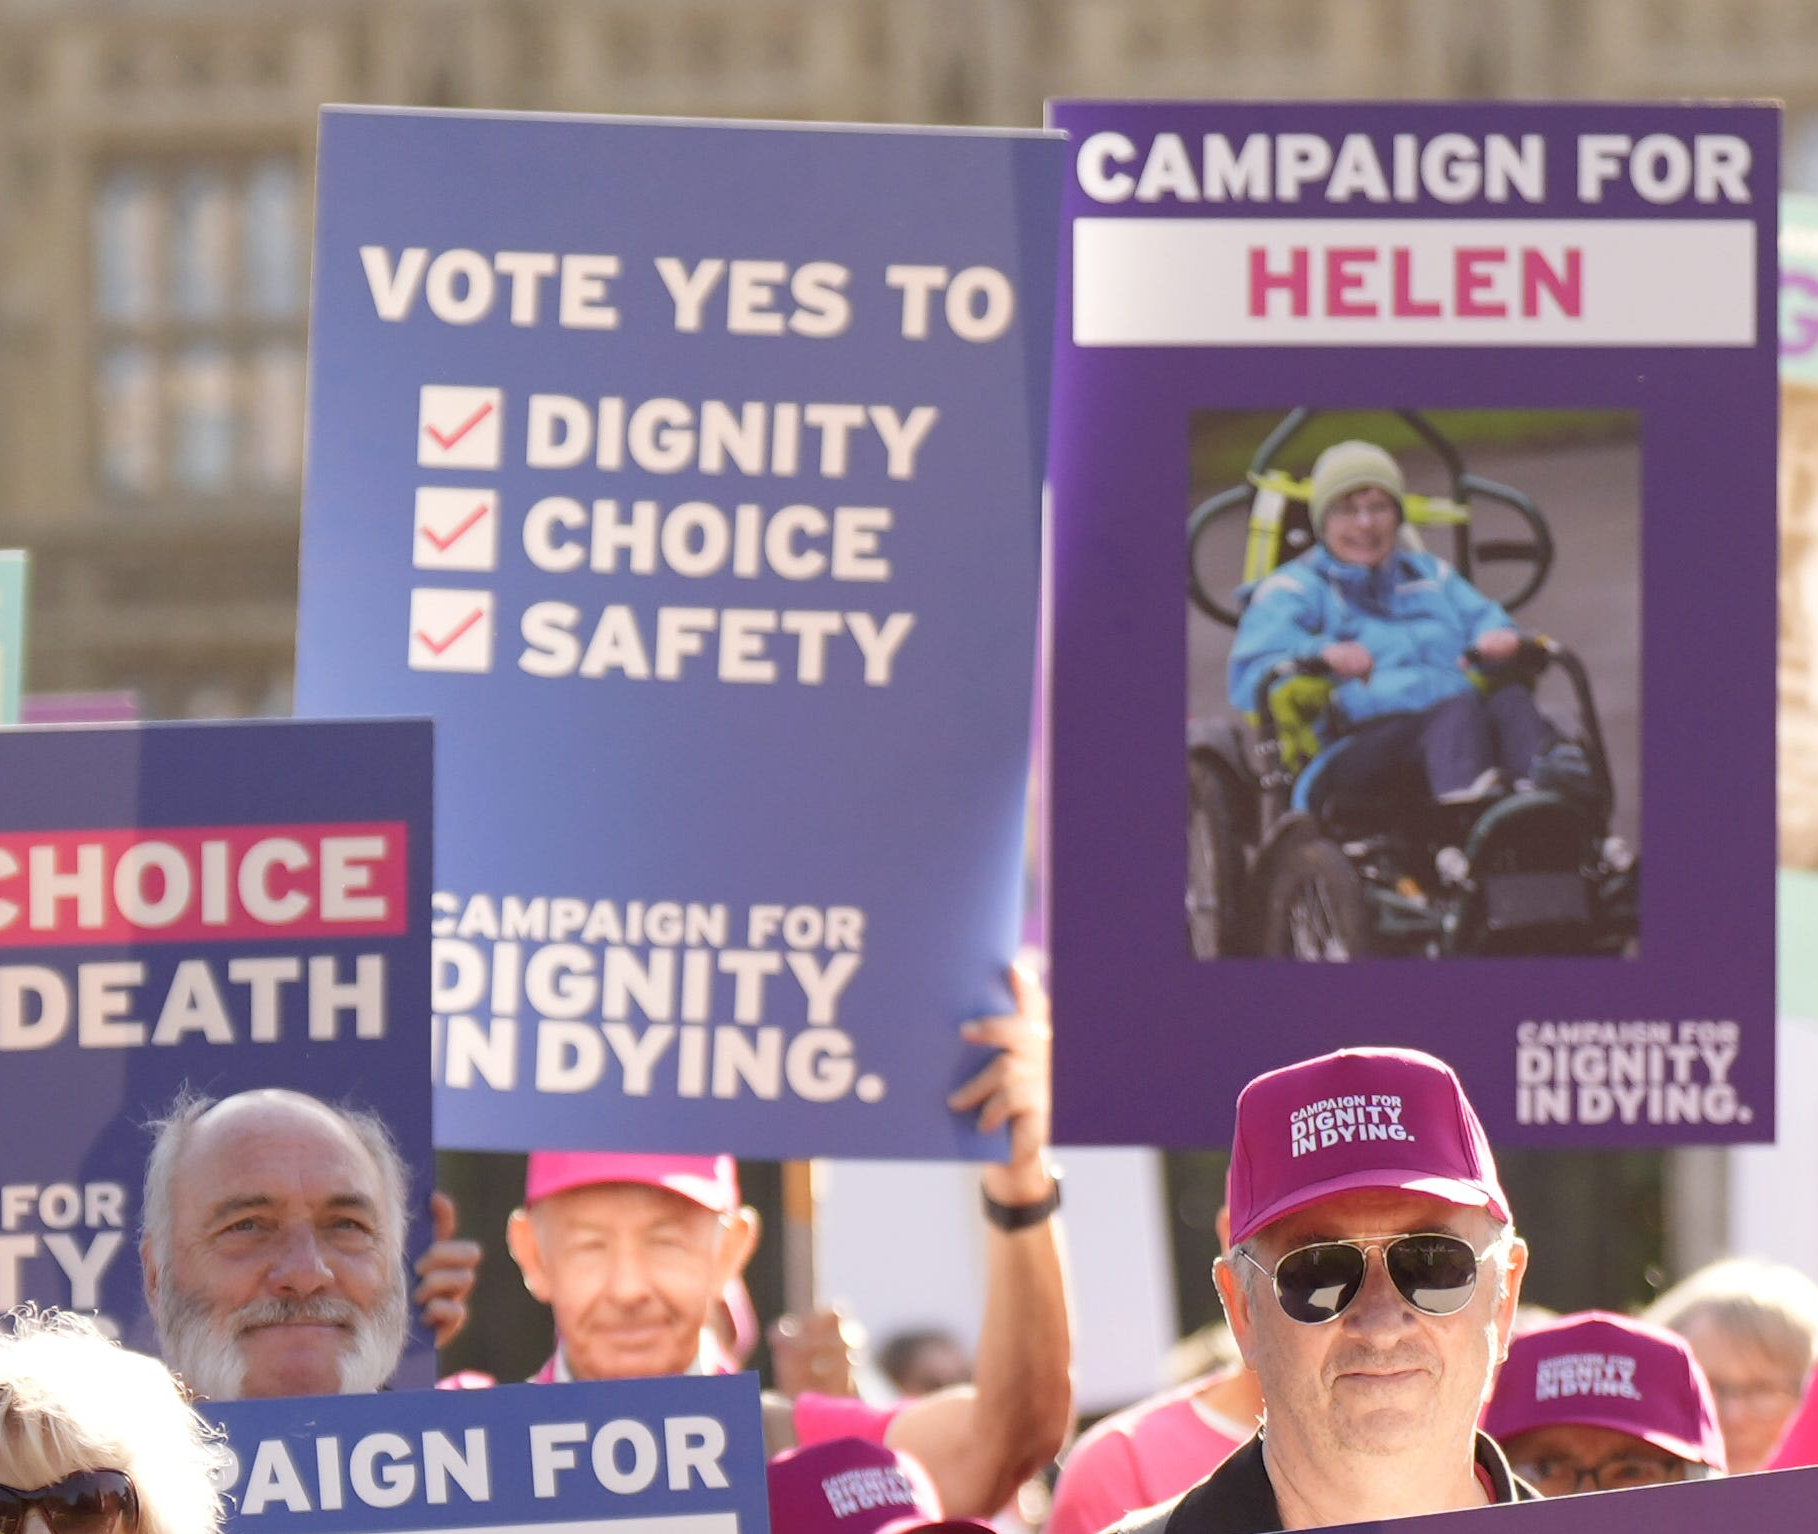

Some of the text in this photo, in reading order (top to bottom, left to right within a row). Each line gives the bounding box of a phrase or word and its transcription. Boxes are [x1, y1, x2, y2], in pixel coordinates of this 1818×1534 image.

[1076, 131, 1751, 203] CAMPAIGN FOR
[360, 245, 1014, 341] VOTE YES TO
[1246, 246, 1583, 318] HELEN
[526, 394, 938, 480] DIGNITY
[522, 497, 892, 581] CHOICE
[517, 601, 913, 686] SAFETY
[431, 892, 865, 950] CAMPAIGN FOR
[433, 942, 862, 1025] DIGNITY
[536, 1022, 887, 1103] DYING.
[1516, 1044, 1740, 1085] DIGNITY
[1291, 1106, 1402, 1141] DIGNITY
[1371, 1095, 1402, 1107] FOR
[1516, 1083, 1754, 1126] IN DYING.
[1292, 1124, 1416, 1157] IN DYING.
[1, 1182, 125, 1231] FOR
[529, 1415, 729, 1501] FOR
